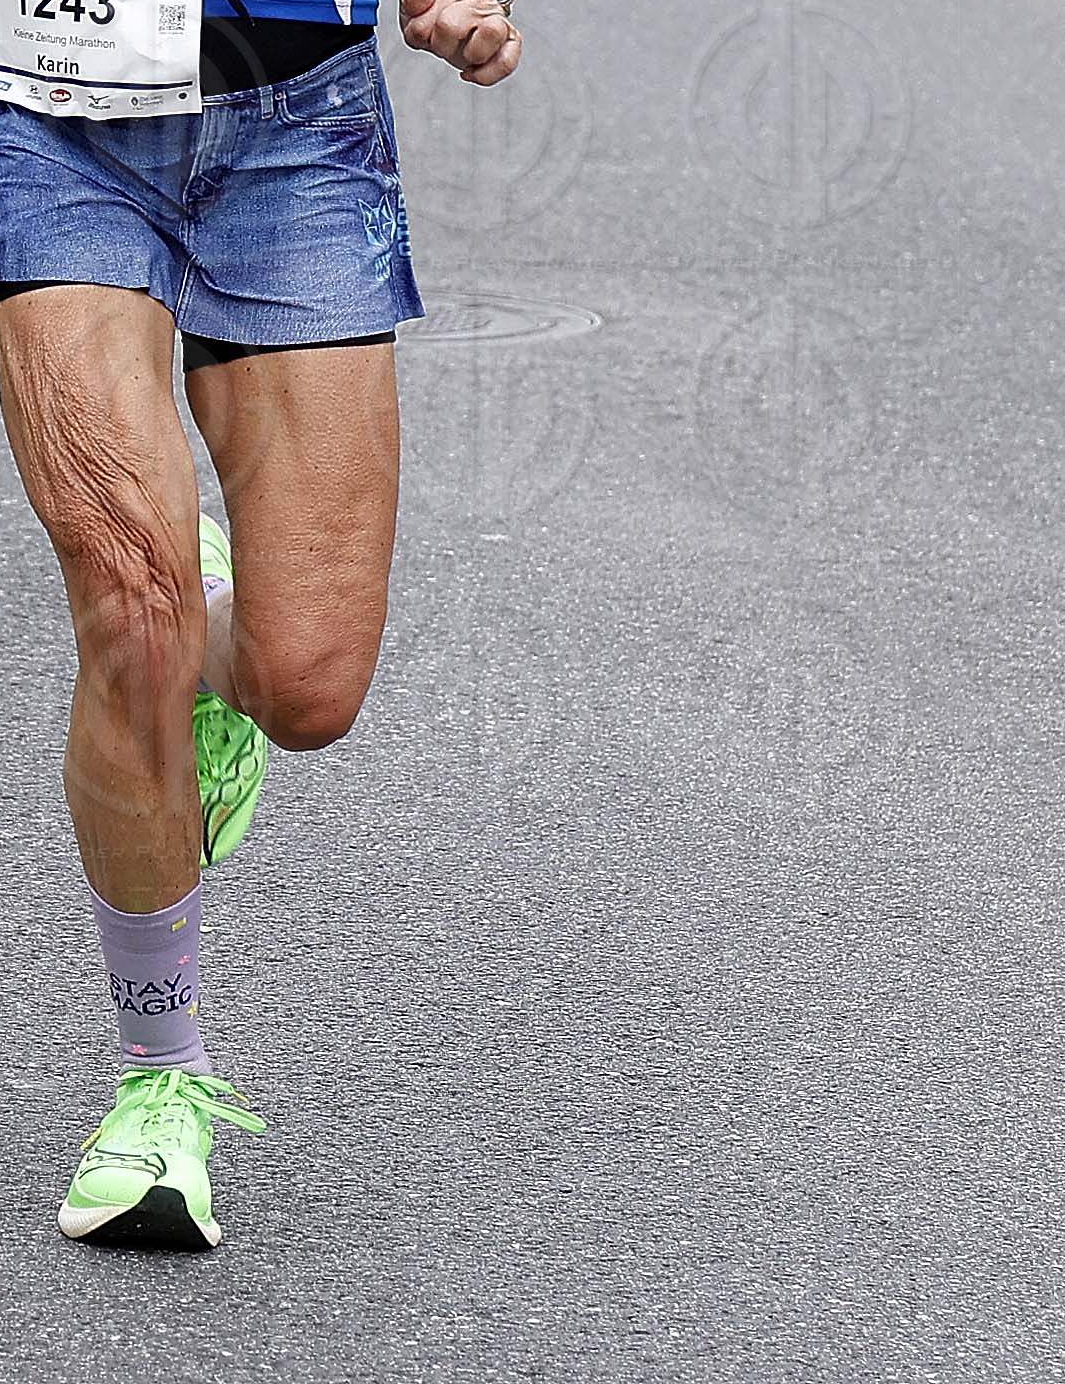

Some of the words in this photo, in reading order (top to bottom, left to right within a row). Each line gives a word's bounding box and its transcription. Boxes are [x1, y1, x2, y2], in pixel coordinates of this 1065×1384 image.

[35, 32, 67, 47] Zeitung
[70, 36, 116, 49] Marathon
[37, 54, 80, 75] Karin
[110, 973, 182, 998] STAY
[110, 985, 192, 1016] MAGIC
